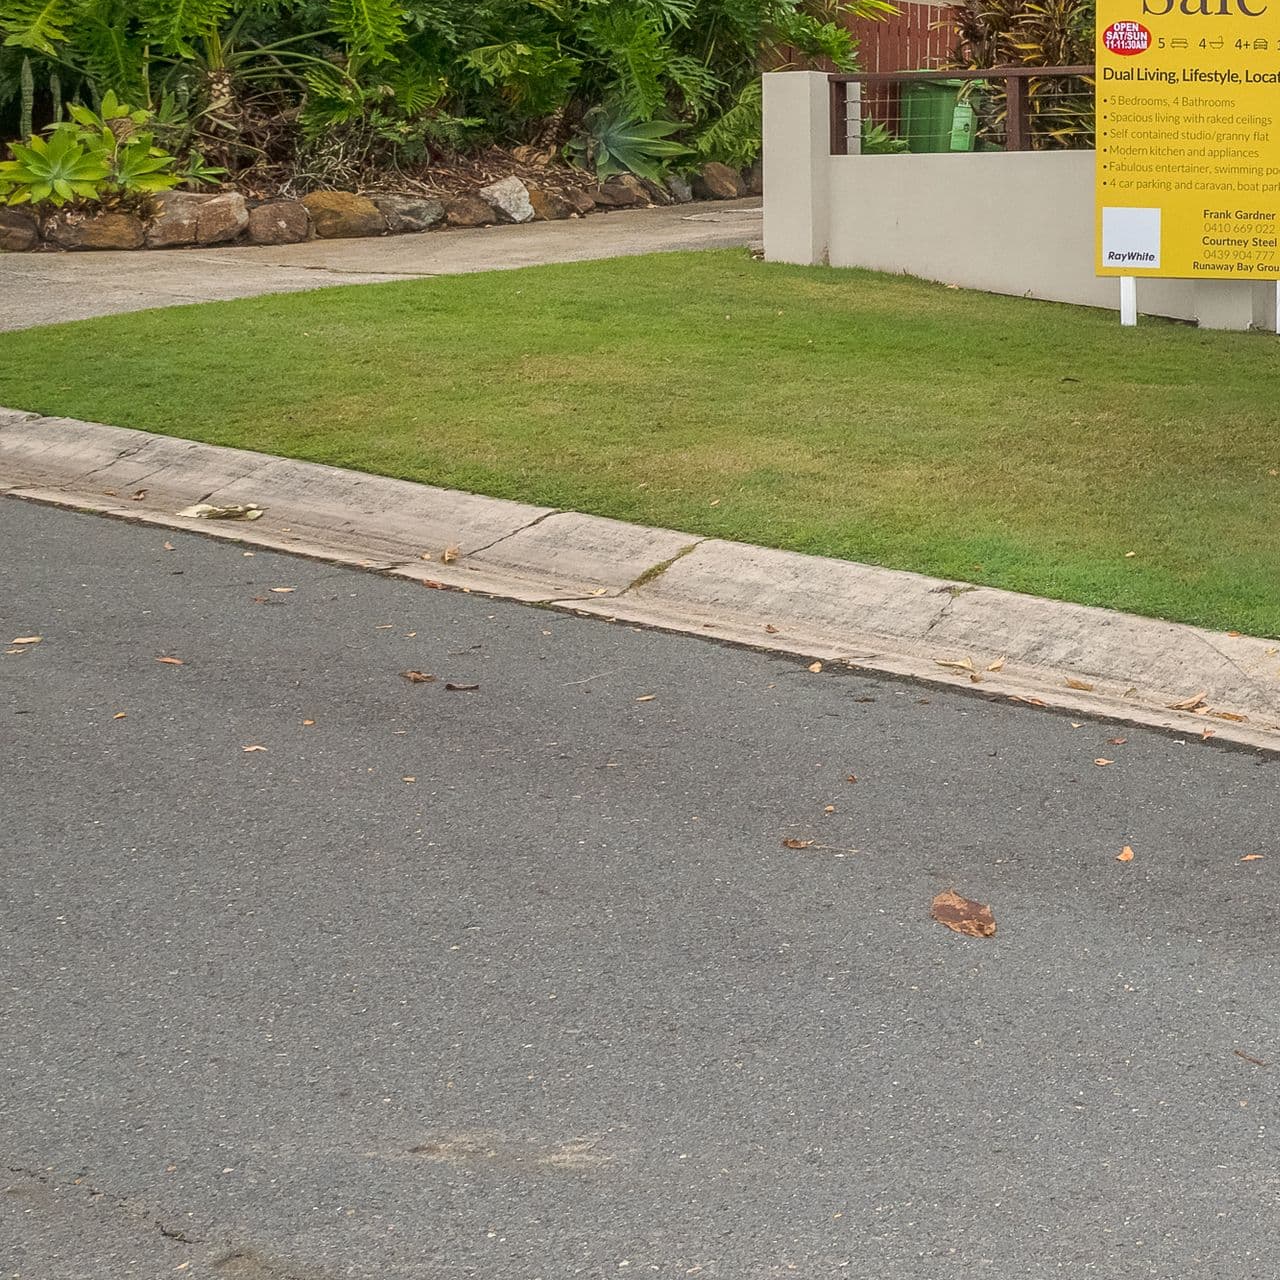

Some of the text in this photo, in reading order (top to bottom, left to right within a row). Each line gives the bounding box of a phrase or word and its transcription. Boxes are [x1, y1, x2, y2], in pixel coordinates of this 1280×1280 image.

[1113, 23, 1139, 31] OPEN
[1106, 31, 1148, 41] SAT/SUN
[1158, 38, 1166, 49] 5
[1199, 38, 1206, 49] 4
[1234, 39, 1251, 50] 4+
[1103, 67, 1134, 81] Dual
[1137, 68, 1179, 84] Living,
[1182, 69, 1242, 85] Lifestyle,
[1110, 96, 1236, 108] 5 Bedrooms, 4 Bathrooms
[1110, 113, 1273, 127] Spacious living with raked ceilings
[1110, 129, 1270, 143] Self contained studio/granny flat
[1110, 146, 1260, 159] Modern kitchen and appliances
[1109, 162, 1153, 173] Fabulous
[1214, 164, 1264, 176] swimming
[1110, 178, 1116, 188] 4
[1119, 180, 1133, 189] car
[1136, 179, 1172, 191] parking
[1174, 180, 1193, 190] and
[1237, 181, 1260, 192] boat
[1203, 209, 1276, 220] Frank Gardner
[1204, 223, 1276, 234] 0410 669 022
[1202, 236, 1277, 248] Courtney Steel
[1203, 249, 1276, 261] 0439 904 777
[1193, 261, 1234, 272] Runaway
[1237, 262, 1254, 272] Bay
